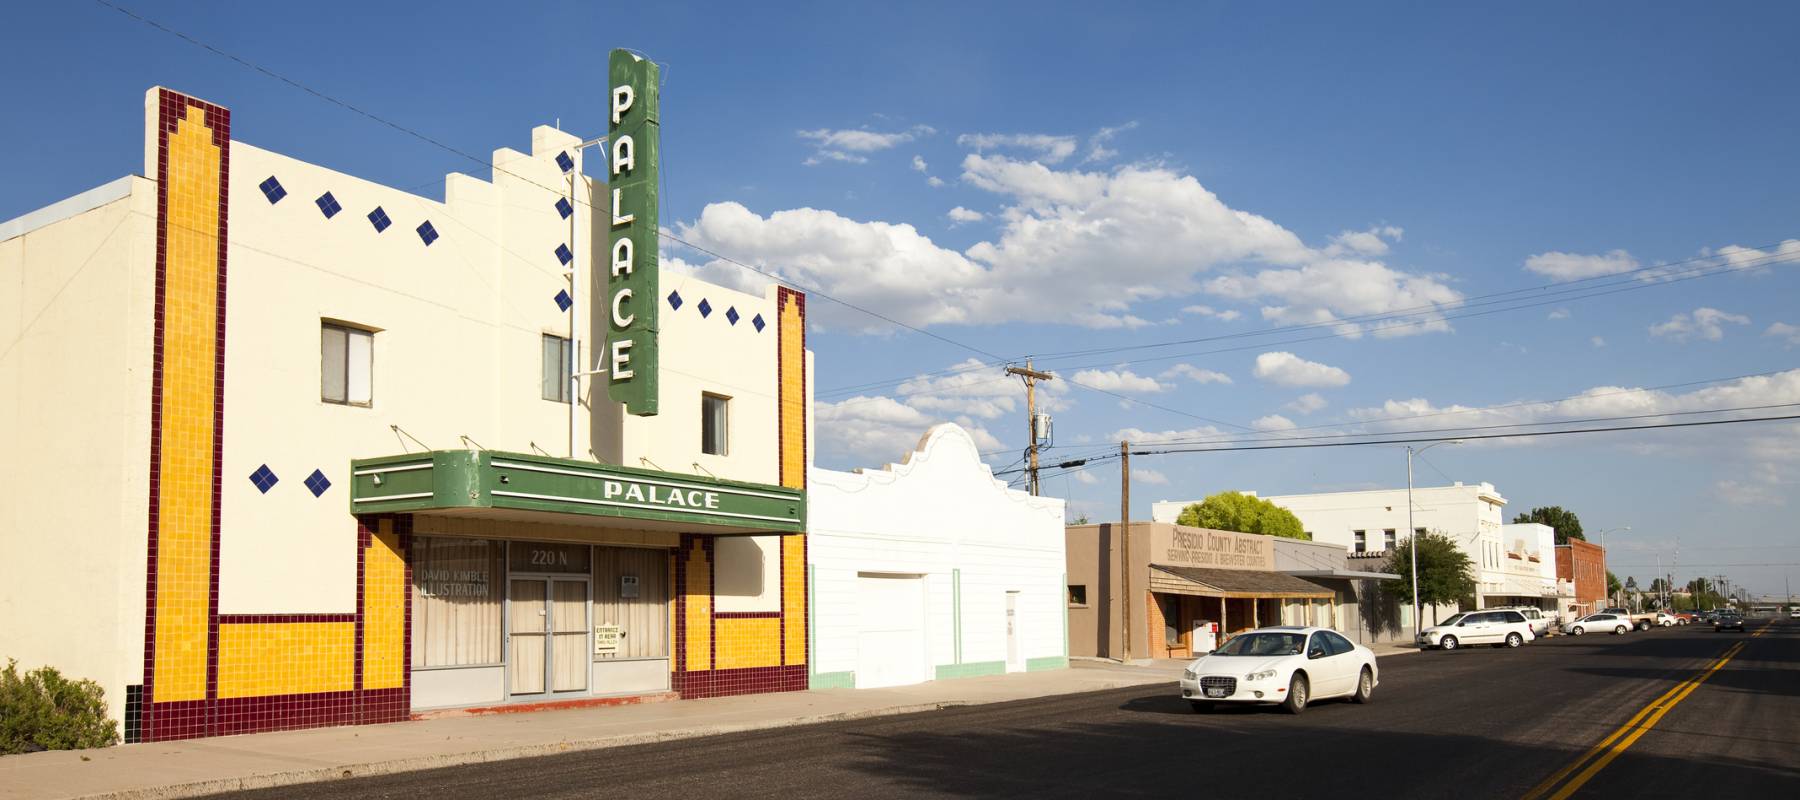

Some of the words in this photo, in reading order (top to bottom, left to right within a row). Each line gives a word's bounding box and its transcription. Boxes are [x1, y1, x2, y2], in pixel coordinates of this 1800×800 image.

[611, 84, 635, 381] PALACE
[604, 480, 720, 509] PALACE
[1172, 527, 1204, 549] PRESIDIO
[1207, 532, 1232, 552] COUNTY
[1235, 536, 1263, 554] ABSTRACT
[531, 550, 555, 565] 220
[559, 551, 568, 565] N
[1167, 549, 1190, 562] SERVING
[421, 568, 450, 581] DAVID
[453, 570, 489, 582] KIMBLE
[421, 582, 489, 597] ILLUSTRATION
